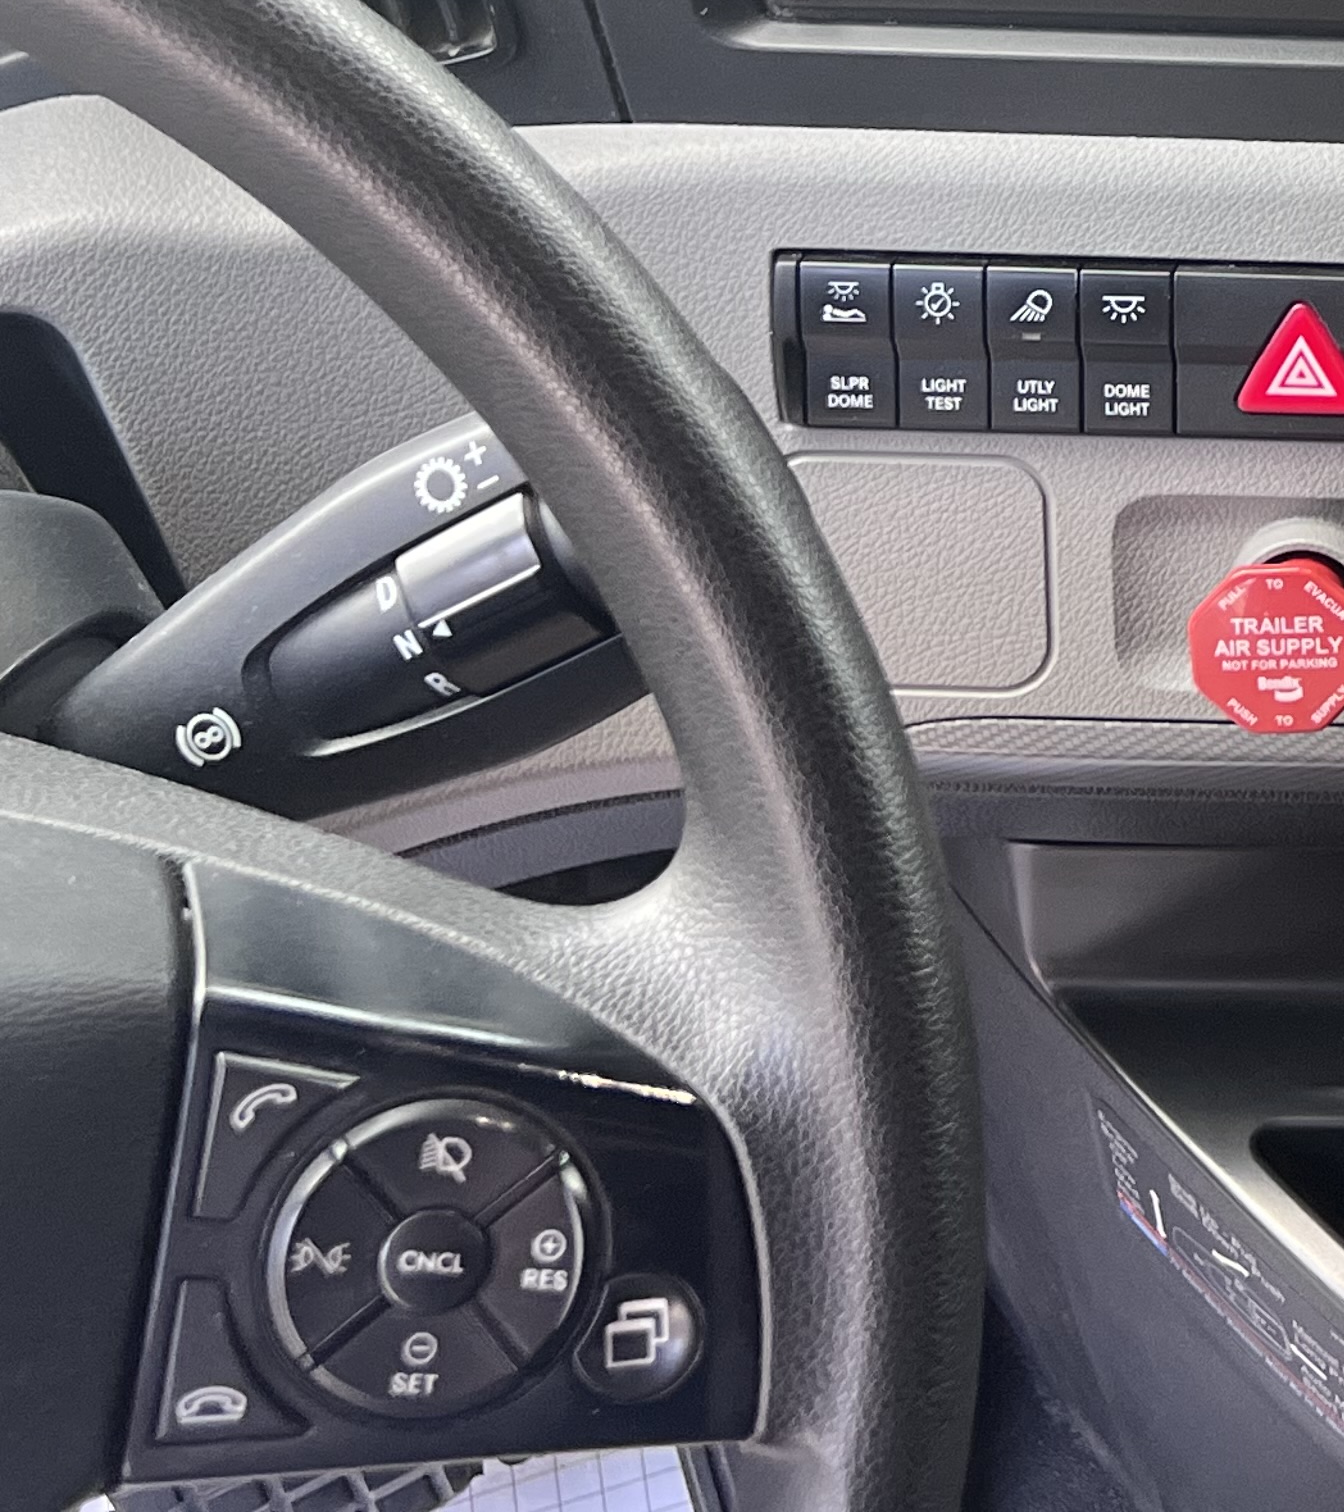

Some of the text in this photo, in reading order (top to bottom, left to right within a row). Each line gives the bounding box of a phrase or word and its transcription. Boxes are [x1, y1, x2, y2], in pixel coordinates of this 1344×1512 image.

[830, 376, 869, 392] SLPR
[921, 378, 966, 393] LIGHT
[1017, 380, 1056, 396] UTLY
[1104, 384, 1150, 400] DOME
[827, 392, 873, 410] DOME
[926, 396, 962, 411] TEST
[1014, 397, 1058, 413] LIGHT
[1104, 402, 1150, 417] LIGHT
[375, 576, 399, 613] D
[1218, 584, 1247, 611] PULL
[1265, 579, 1283, 590] TO
[1230, 616, 1324, 635] TRAILER
[393, 629, 424, 661] N
[1214, 636, 1343, 657] AIR SUPPLY
[1222, 657, 1338, 671] NOT FOR PARKING
[423, 671, 461, 697] R
[1257, 676, 1302, 691] Bendix
[1227, 698, 1258, 726] PUSH
[1275, 715, 1294, 727] TO
[399, 1249, 465, 1274] CNCL
[520, 1268, 569, 1291] RES
[389, 1372, 439, 1396] SET
